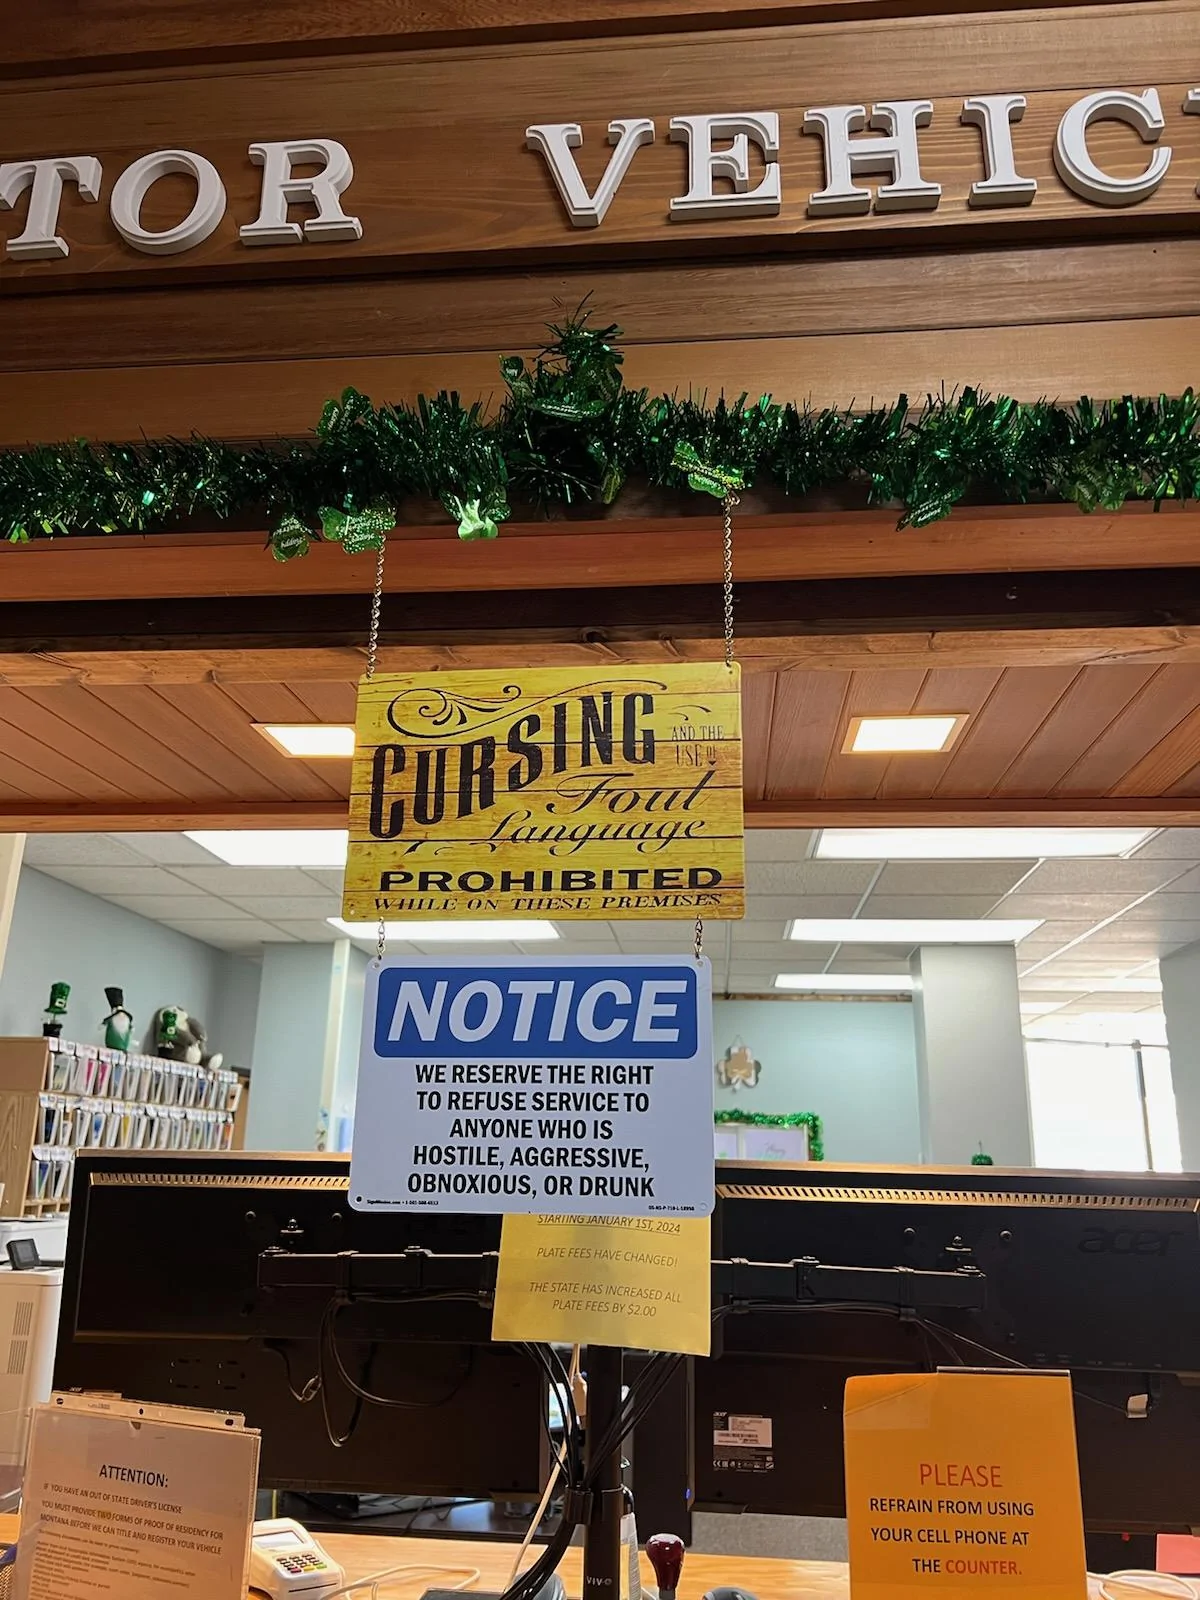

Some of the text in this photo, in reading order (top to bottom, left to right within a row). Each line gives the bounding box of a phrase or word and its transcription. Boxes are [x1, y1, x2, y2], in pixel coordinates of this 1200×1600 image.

[0, 87, 1200, 261] TOR VEHIC
[672, 724, 724, 741] AND THE
[369, 691, 655, 839] CURSING
[675, 744, 703, 767] USE
[546, 769, 717, 814] Foul
[470, 809, 706, 857] Language
[379, 867, 723, 892] PROHIBITED
[374, 893, 723, 911] WHILE ON THESE PREMISES
[387, 980, 688, 1043] NOTICE
[416, 1064, 654, 1085] WE RESERVE THE RIGHT
[417, 1091, 650, 1113] TO REFUSE SERVICE TO
[449, 1119, 613, 1140] ANYONE WHO IS
[413, 1146, 650, 1172] HOSTILE, AGGRESSIVE,
[407, 1173, 655, 1199] OBNOXIOUS, OR DRUNK
[537, 1214, 681, 1233] STARTING JANUARY 1ST, 2024
[1080, 1227, 1184, 1256] acer
[537, 1247, 678, 1268] PLATE FEES HAVE CHANGED!
[529, 1282, 681, 1303] THE STATE HAS INCREASED ALL
[553, 1300, 657, 1317] PLATE FEES BY $2.00
[99, 1464, 169, 1488] ATTENTION:
[920, 1464, 1003, 1488] PLEASE
[51, 1483, 63, 1492] YOU
[63, 1486, 79, 1496] HAVE
[80, 1489, 89, 1497] AN
[89, 1491, 102, 1500] OUT
[102, 1493, 112, 1501] OF
[112, 1495, 129, 1505] STATE
[130, 1498, 158, 1510] DRIVER'S
[158, 1502, 183, 1514] LICENSE
[870, 1498, 1034, 1516] REFRAIN FROM USING
[42, 1500, 224, 1541] YOU MUST PROVIDE TWO FORMS OF PROOF OF RESIDENCY FOR
[40, 1513, 69, 1526] MONTANA
[70, 1517, 91, 1531] BEFORE
[91, 1522, 102, 1533] WE
[102, 1525, 115, 1535] CAN
[116, 1528, 132, 1538] TITLE
[132, 1531, 146, 1541] AND
[148, 1533, 176, 1547] REGISTER
[177, 1538, 195, 1550] YOUR
[196, 1542, 222, 1555] VEHICLE
[871, 1527, 1029, 1546] YOUR CELL PHONE AT
[912, 1558, 1023, 1575] THE COUNTER.
